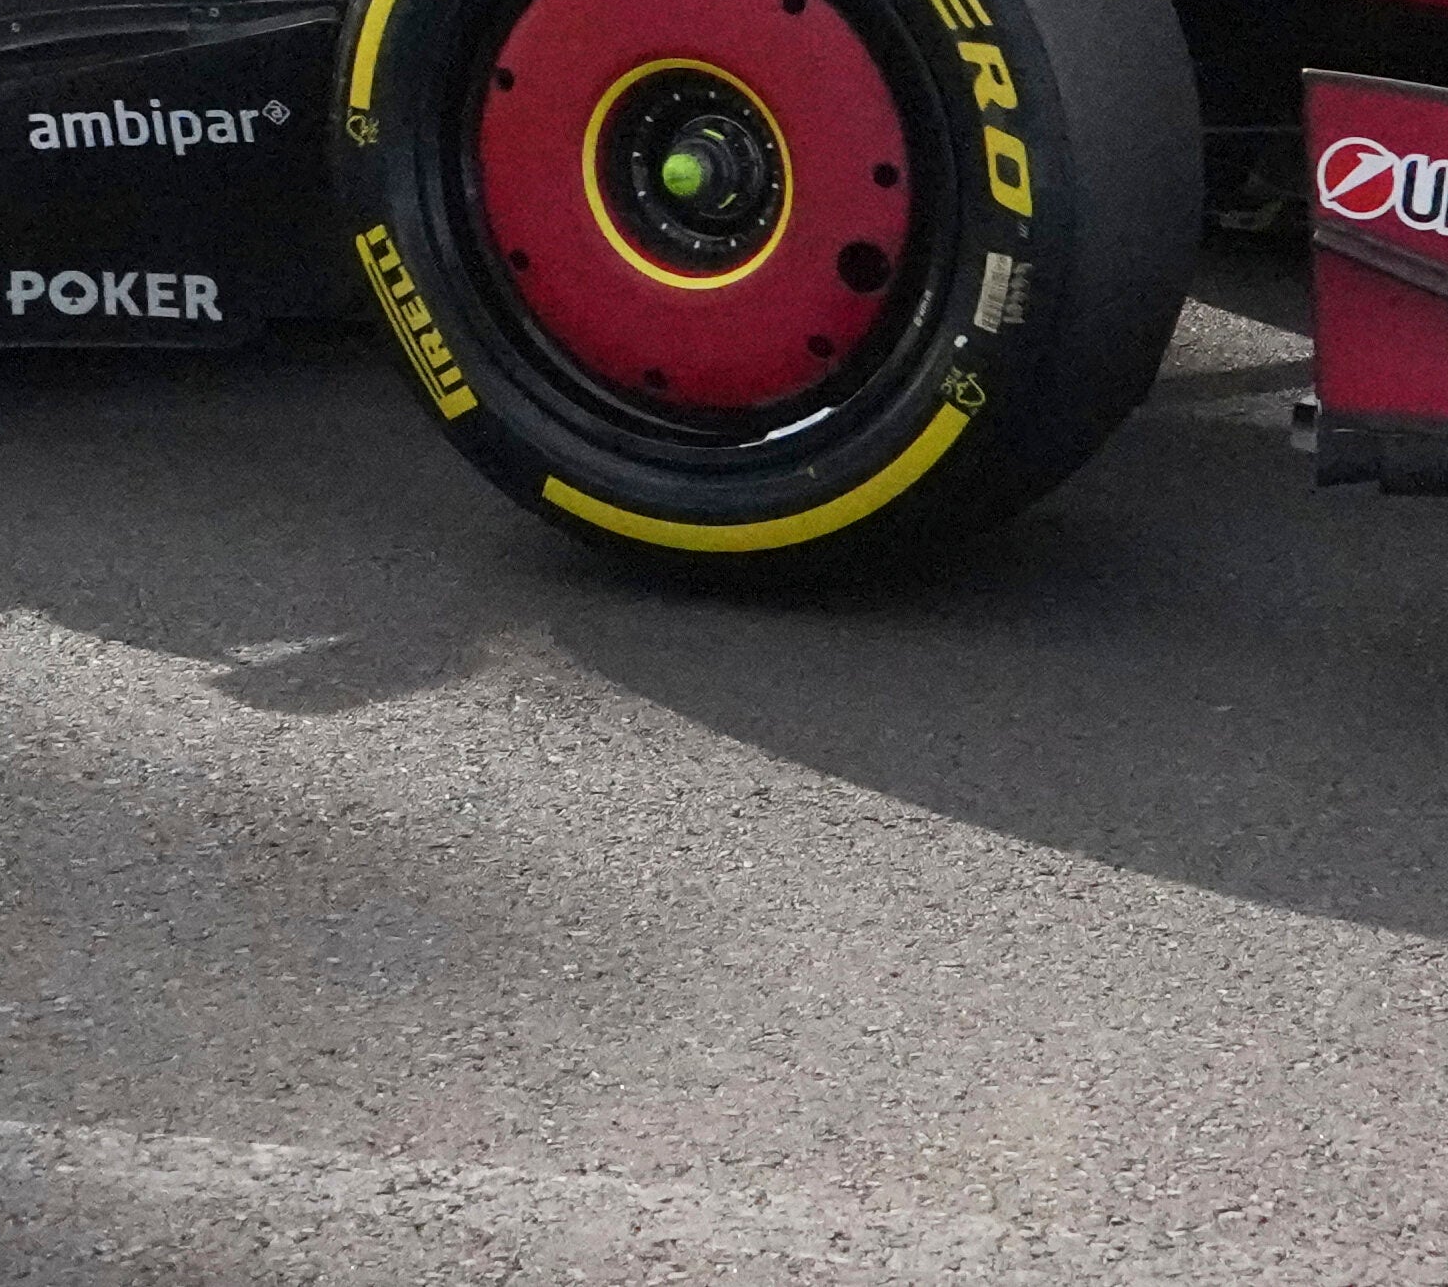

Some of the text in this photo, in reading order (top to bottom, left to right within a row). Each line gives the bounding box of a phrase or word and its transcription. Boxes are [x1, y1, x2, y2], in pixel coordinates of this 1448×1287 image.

[28, 100, 261, 156] ambipar
[5, 268, 224, 323] POKER
[354, 224, 479, 421] PIRELLI
